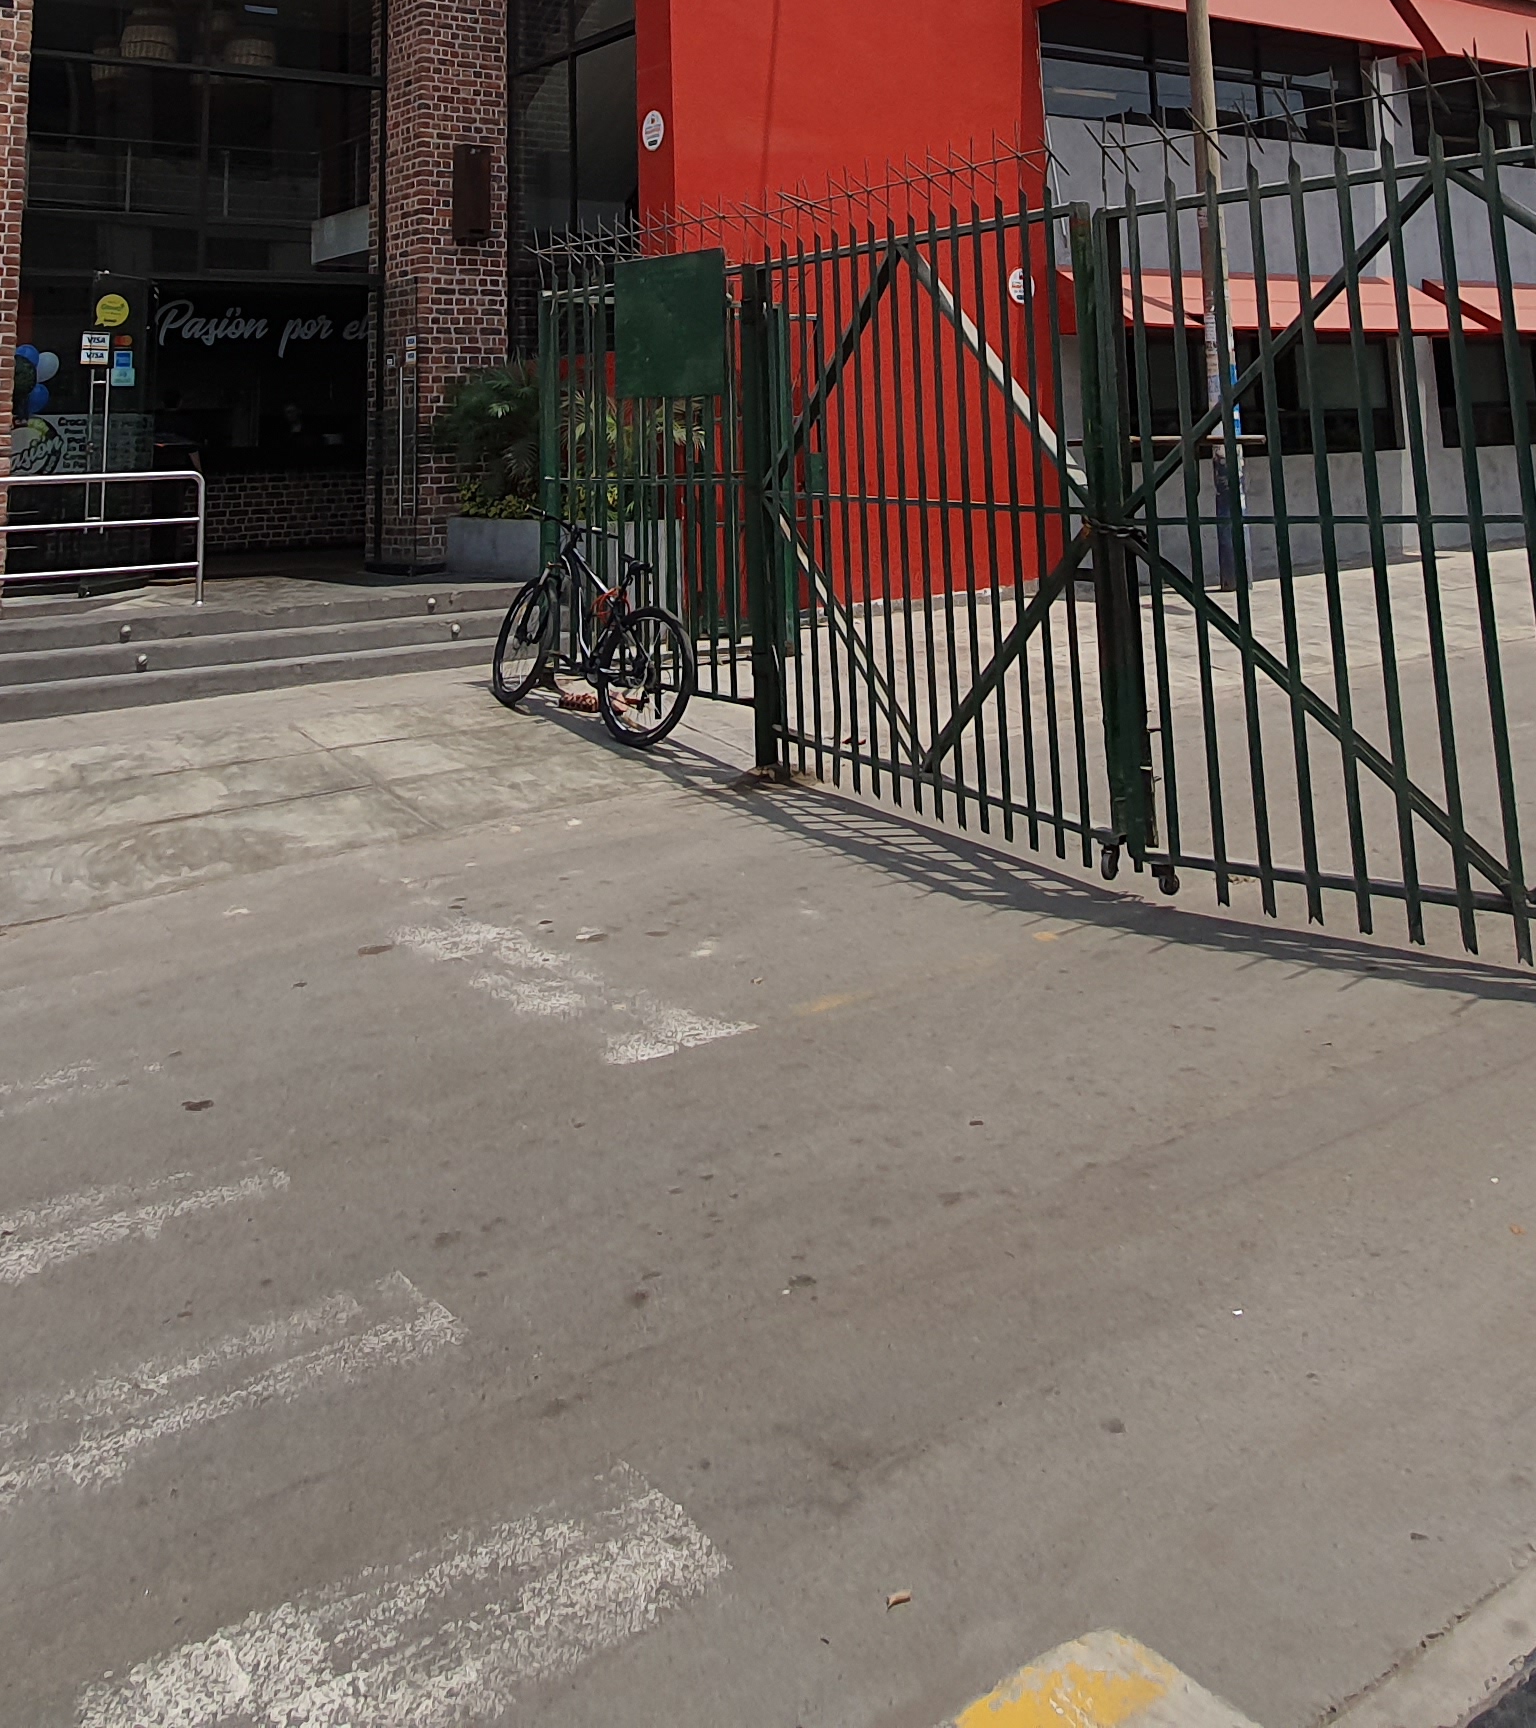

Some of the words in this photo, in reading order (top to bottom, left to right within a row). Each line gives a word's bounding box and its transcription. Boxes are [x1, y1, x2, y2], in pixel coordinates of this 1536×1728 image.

[87, 336, 106, 344] VISA
[155, 299, 269, 346] Pasión
[277, 314, 334, 359] por
